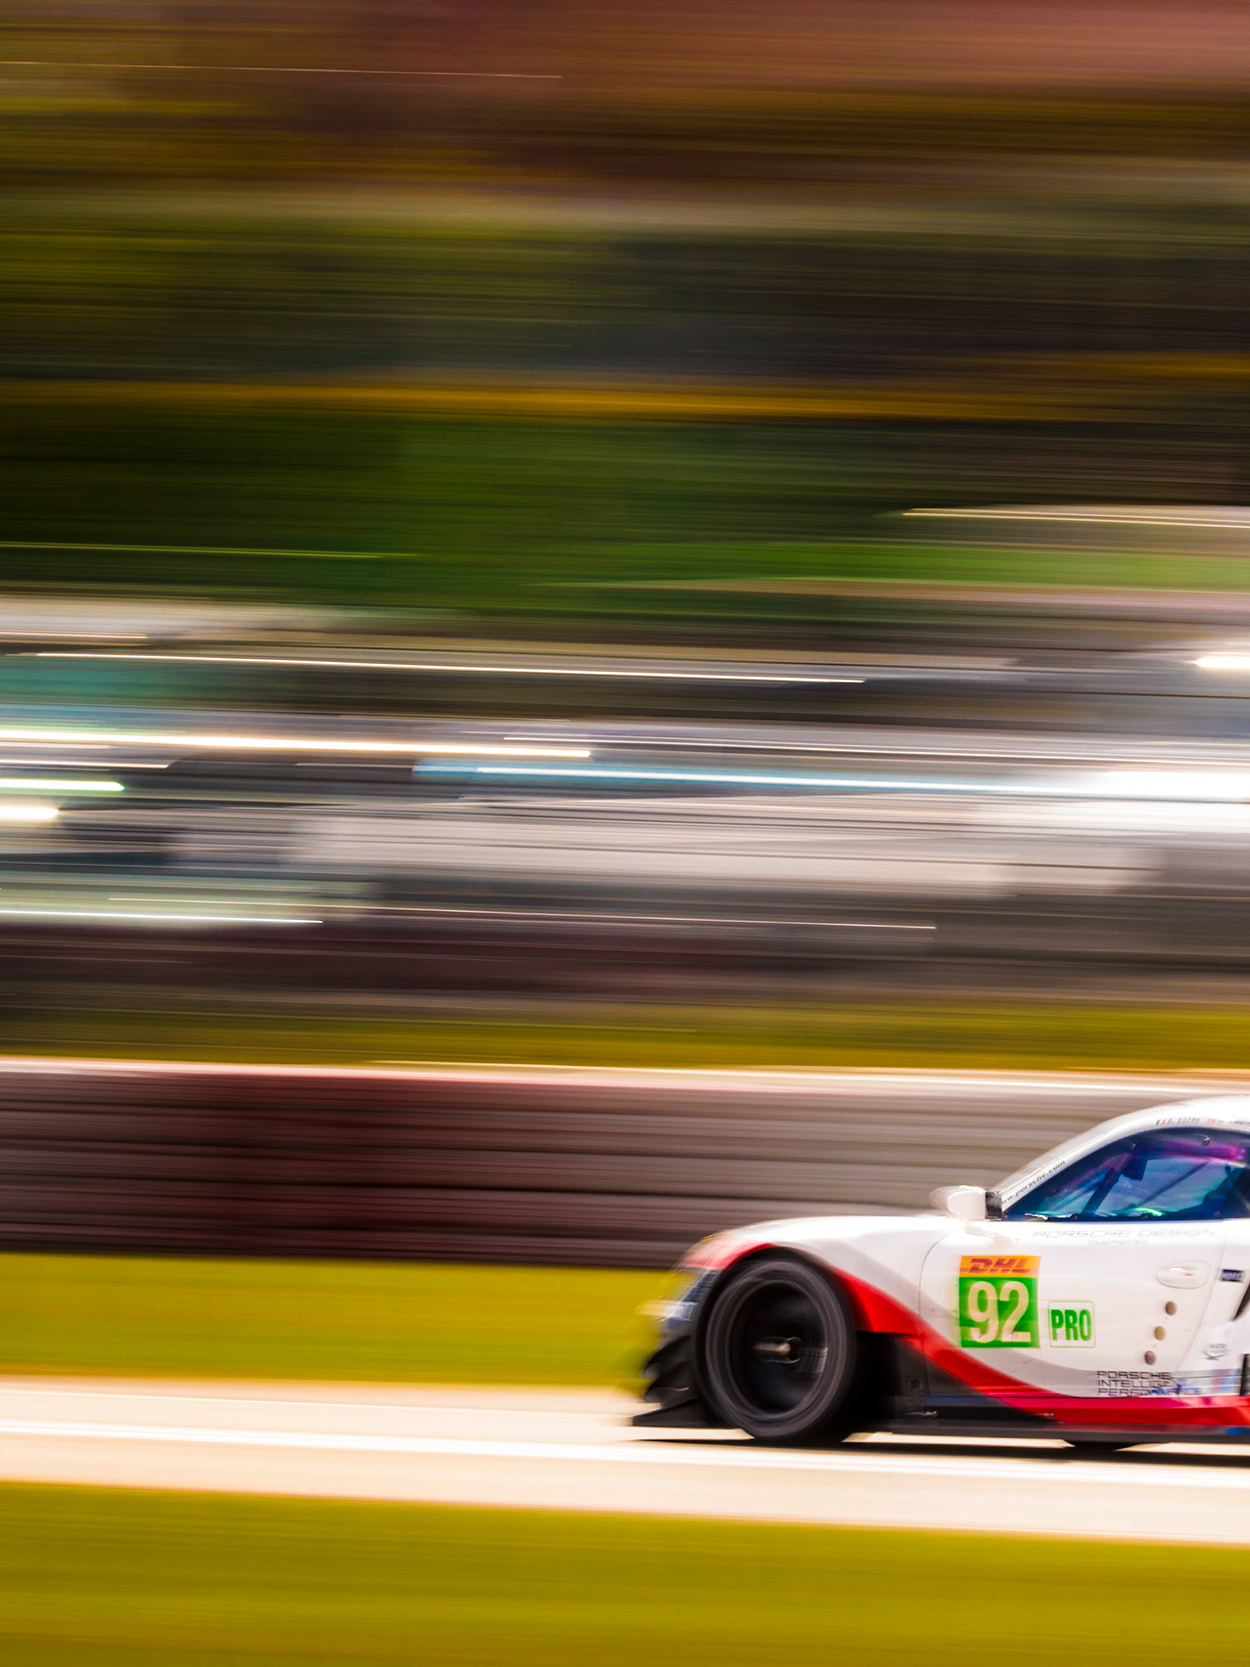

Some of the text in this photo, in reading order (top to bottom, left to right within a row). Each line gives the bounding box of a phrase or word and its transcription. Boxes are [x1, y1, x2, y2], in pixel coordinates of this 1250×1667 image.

[1032, 1229, 1217, 1239] PORSCHE DESIGN
[966, 1258, 1032, 1274] DHL
[968, 1281, 1031, 1343] 92
[1051, 1309, 1092, 1342] PRO
[1097, 1370, 1173, 1381] PORSCHE
